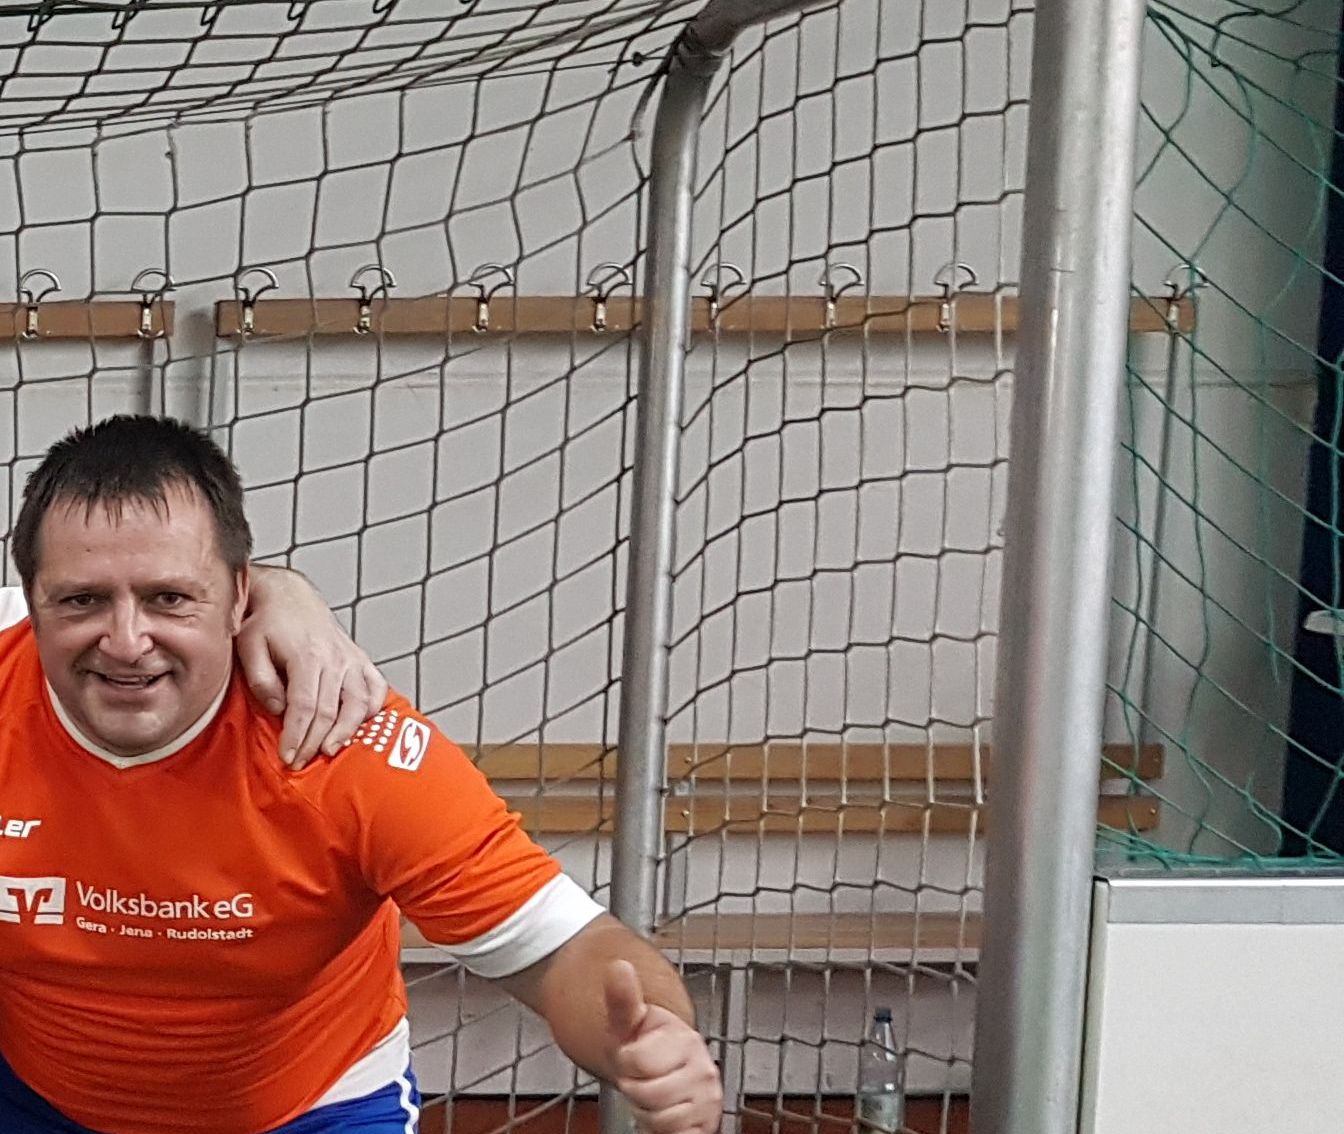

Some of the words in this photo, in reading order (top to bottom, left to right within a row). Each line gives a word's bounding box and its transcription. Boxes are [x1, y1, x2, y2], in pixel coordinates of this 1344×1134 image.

[75, 880, 210, 919] Volksbank
[75, 917, 108, 934] Gera
[119, 924, 154, 938] Jena
[166, 927, 254, 941] Rudolstadt
